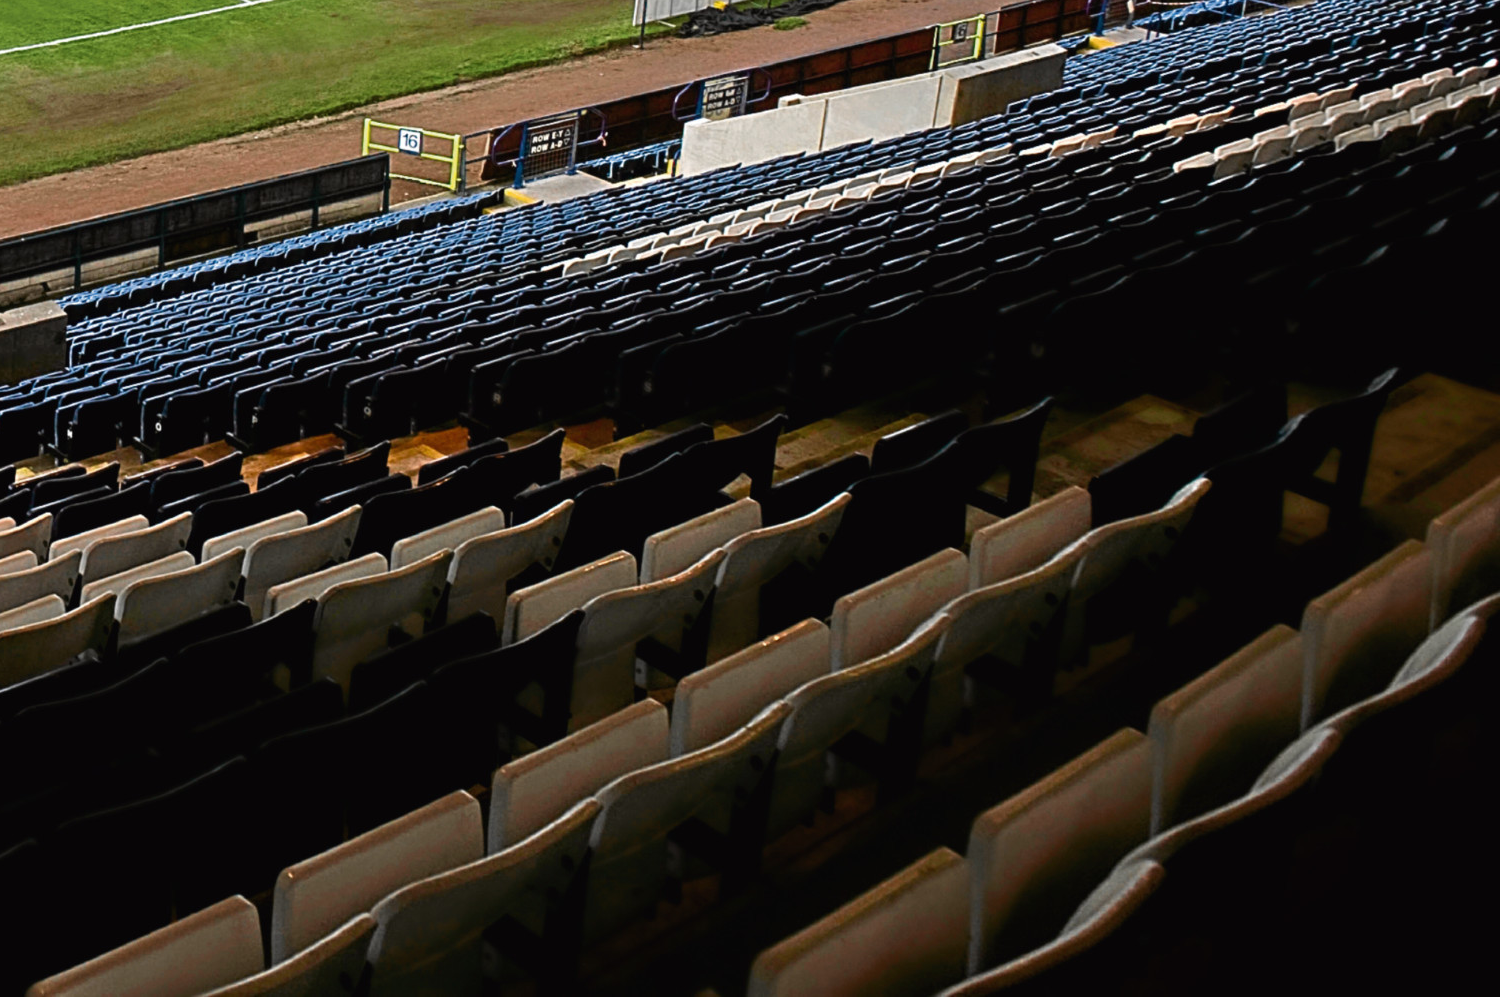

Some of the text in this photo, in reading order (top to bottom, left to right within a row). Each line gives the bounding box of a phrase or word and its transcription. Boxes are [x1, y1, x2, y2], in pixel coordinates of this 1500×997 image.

[402, 133, 418, 149] 16
[532, 130, 564, 144] ROW E-Y
[531, 140, 564, 154] ROW A-D
